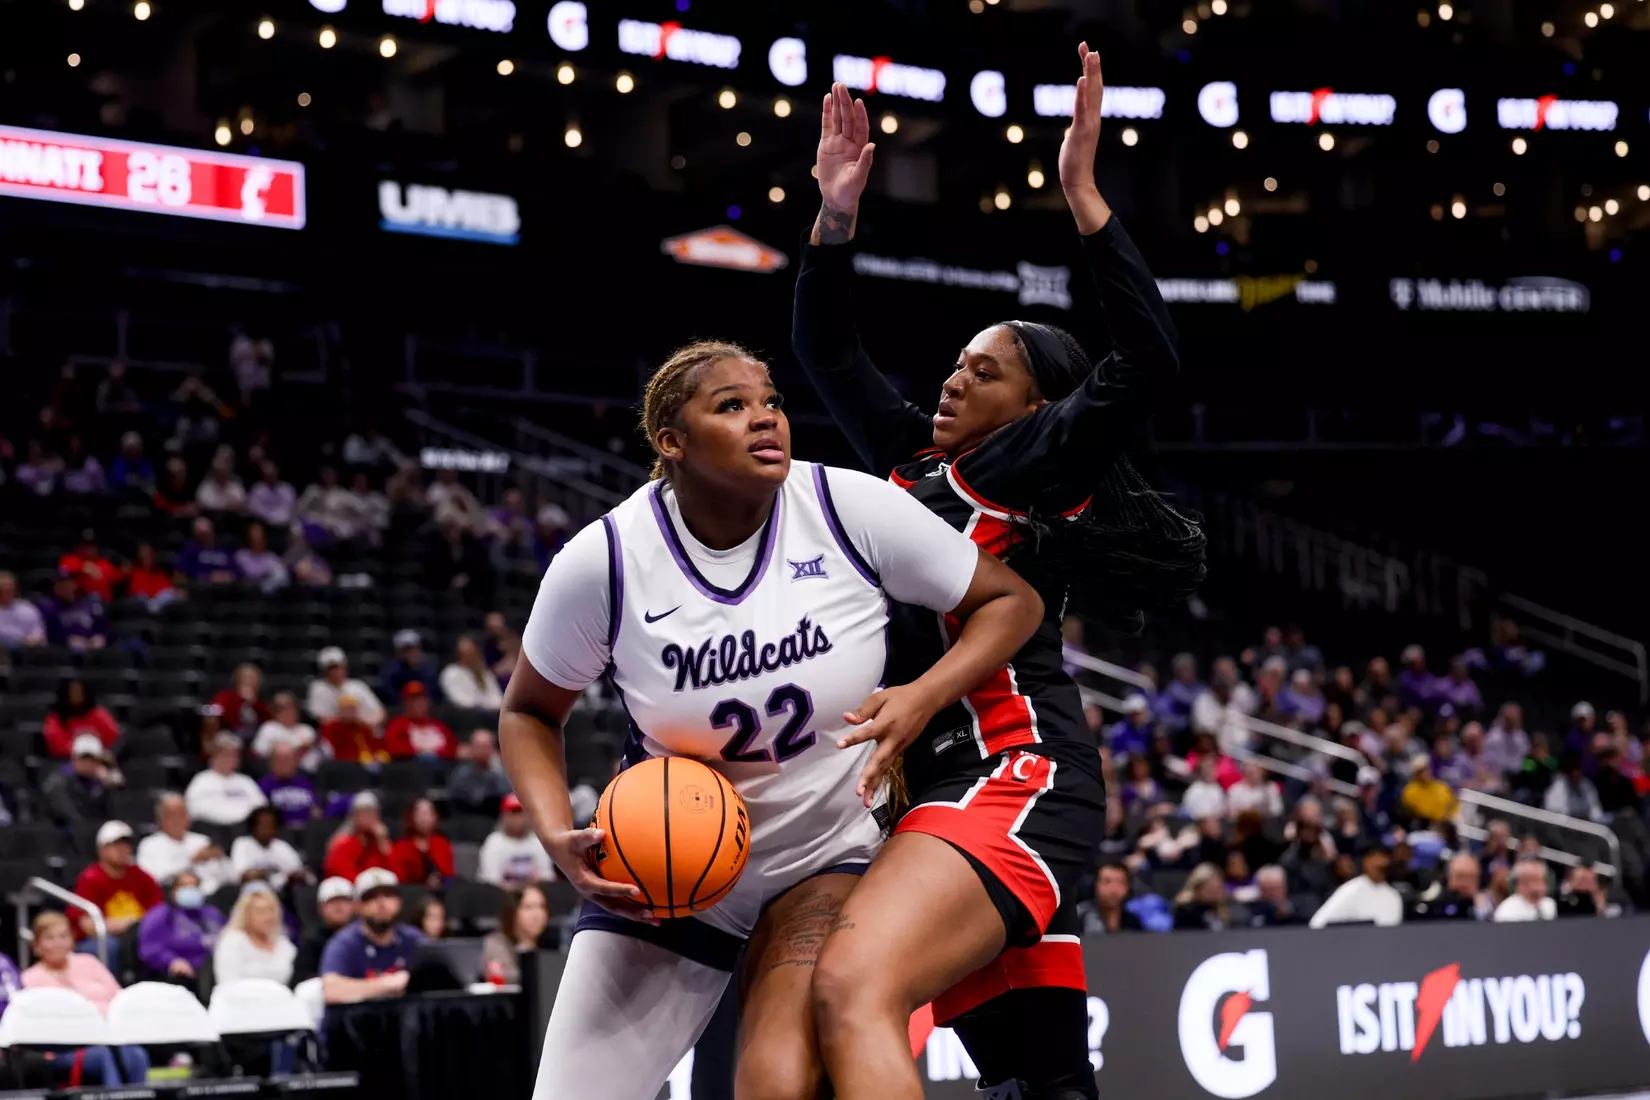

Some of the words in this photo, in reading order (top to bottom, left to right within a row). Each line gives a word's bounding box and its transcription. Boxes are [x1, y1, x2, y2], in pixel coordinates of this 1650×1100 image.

[787, 554, 828, 582] XII
[661, 613, 833, 692] Wildcats
[709, 682, 816, 764] 22
[956, 730, 968, 739] XL
[1012, 755, 1037, 780] C
[1178, 949, 1277, 1099] G
[1337, 984, 1380, 1054] IS
[1379, 982, 1418, 1051] IT
[1484, 972, 1585, 1043] YOU?
